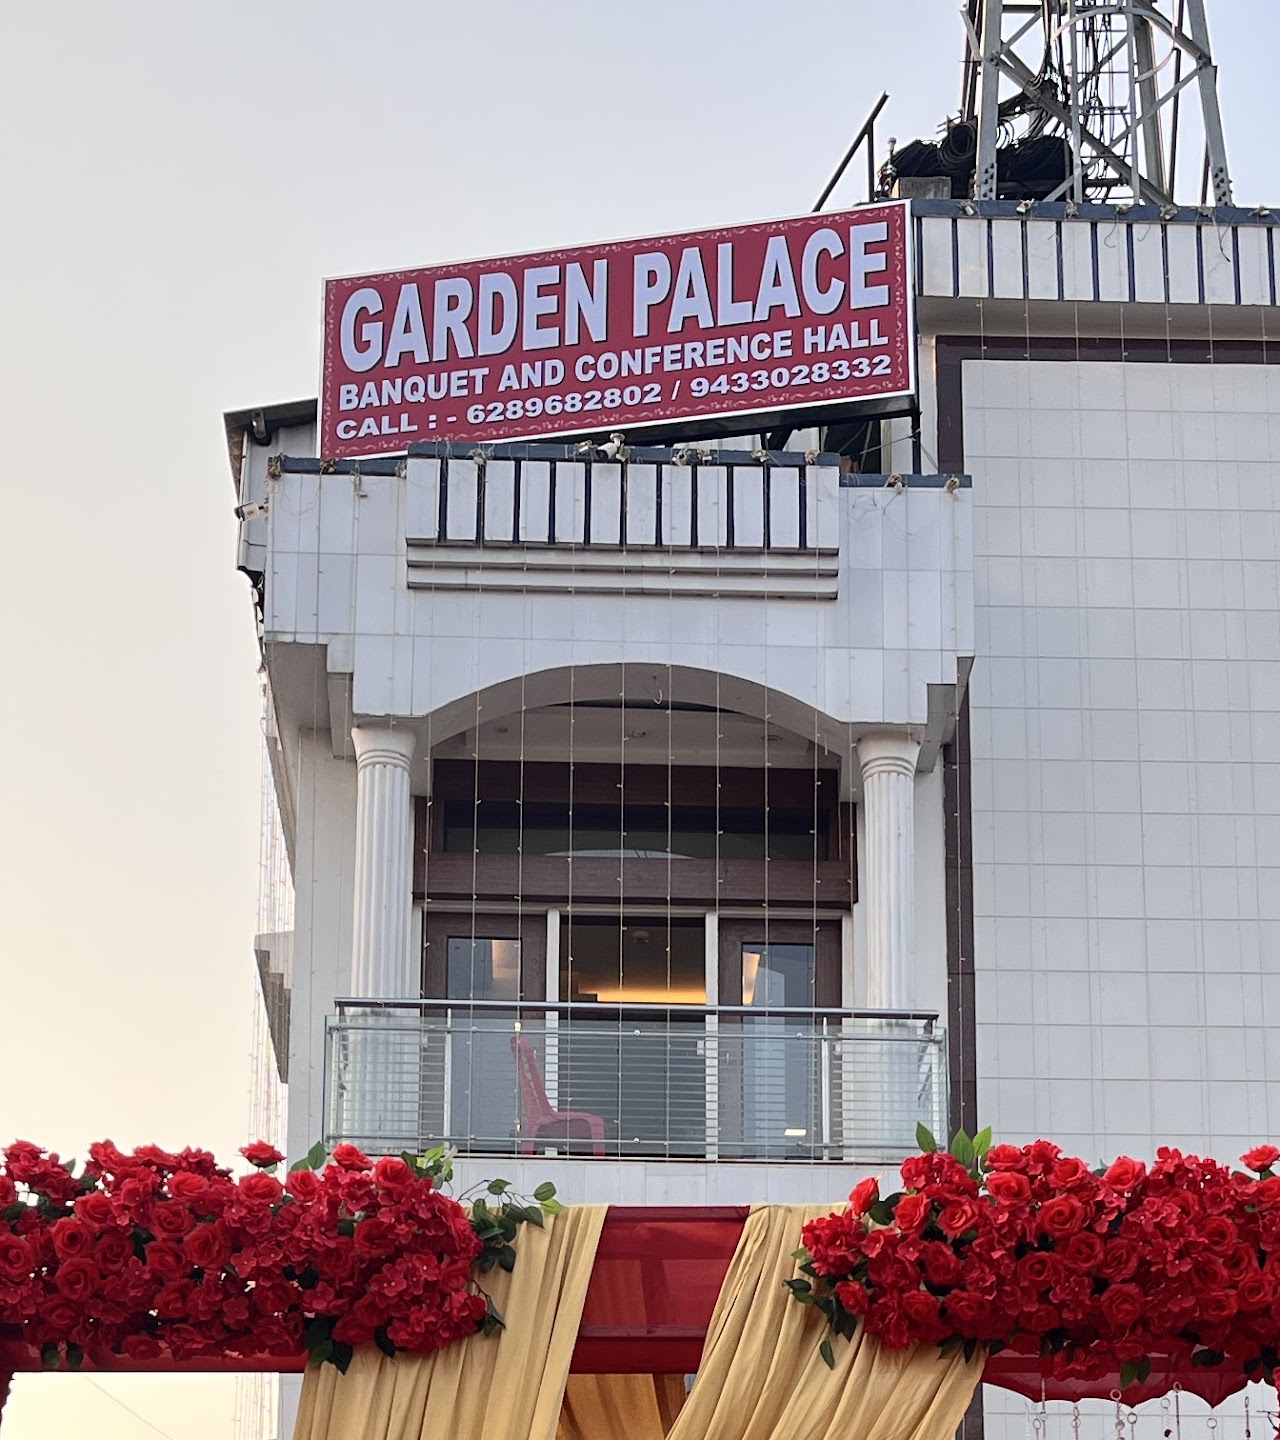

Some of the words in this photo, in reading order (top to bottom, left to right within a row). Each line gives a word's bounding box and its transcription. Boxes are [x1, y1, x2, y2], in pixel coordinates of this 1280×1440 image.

[340, 258, 607, 372] GARDEN
[632, 221, 890, 337] PALACE
[336, 412, 418, 440] CALL
[466, 383, 662, 424] 6289682802
[670, 380, 681, 401] /
[689, 354, 892, 398] 9433028332
[339, 367, 489, 411] BANQUET
[498, 358, 565, 392] AND
[575, 330, 793, 379] CONFERENCE
[803, 319, 889, 355] HALL
